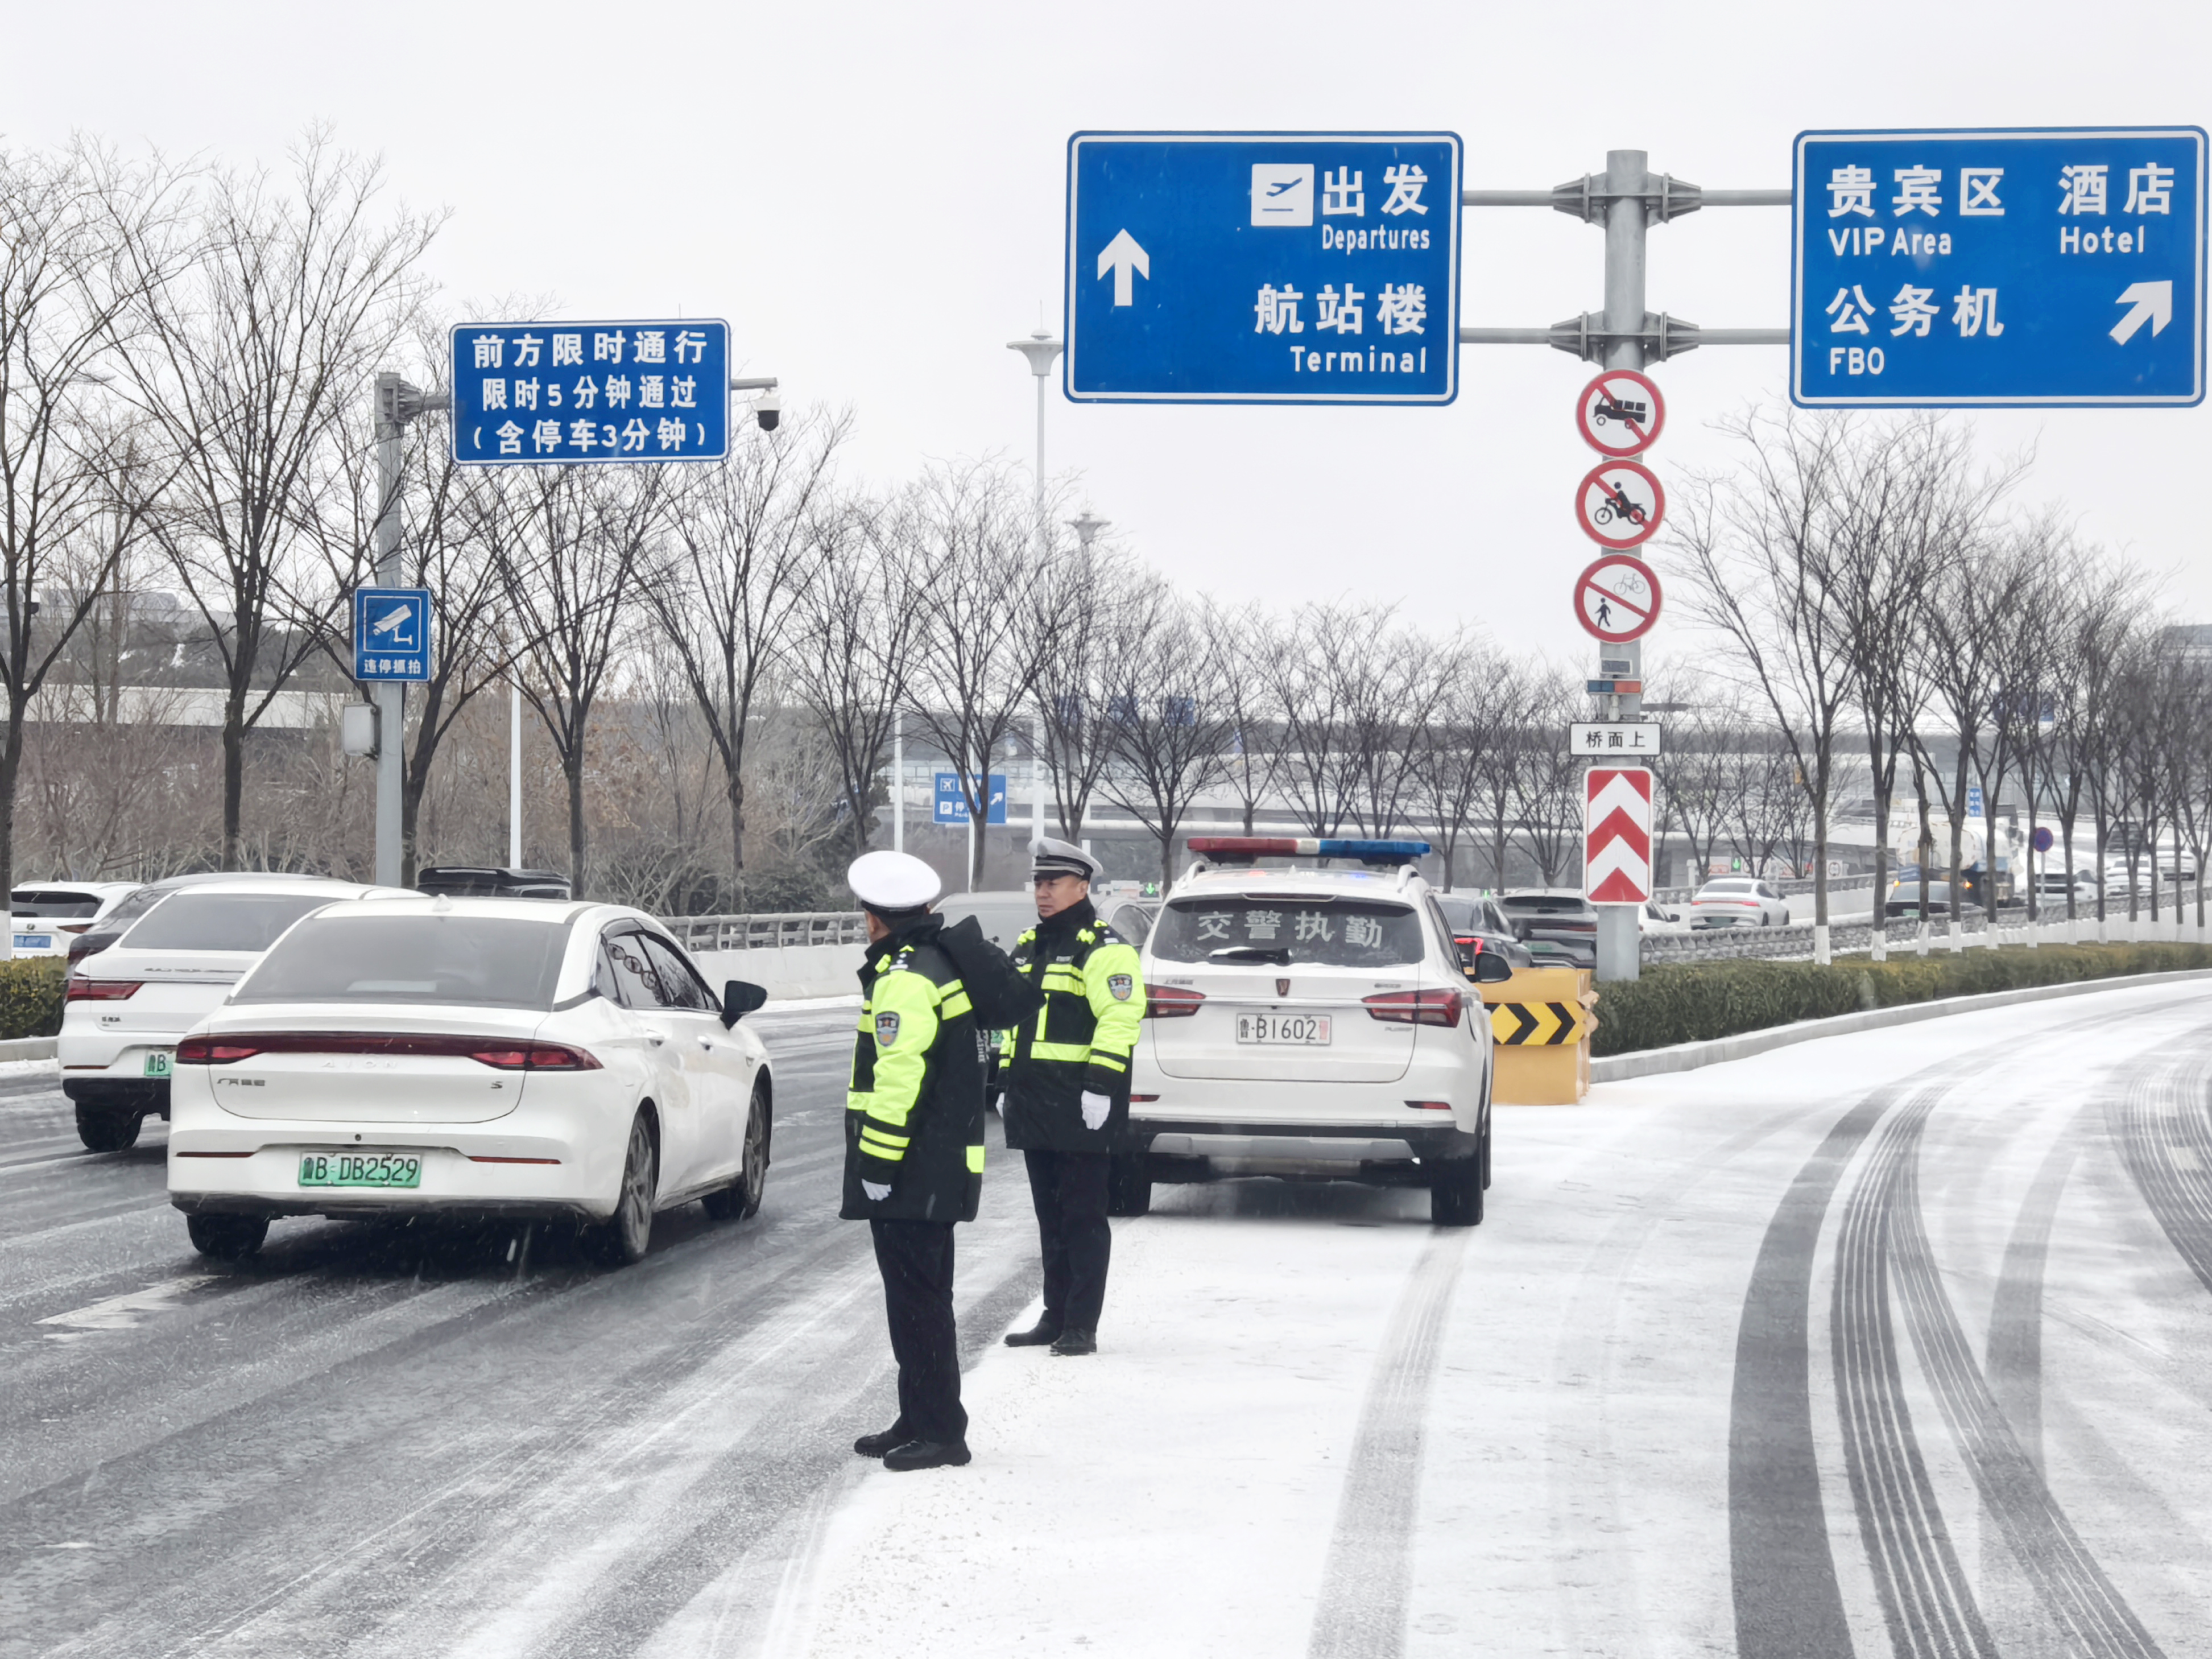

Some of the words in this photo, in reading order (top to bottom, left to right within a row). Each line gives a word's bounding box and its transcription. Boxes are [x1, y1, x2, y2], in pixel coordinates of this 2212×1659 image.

[1322, 164, 1429, 217] 出发
[1826, 164, 2005, 218] 贵宾区
[2058, 162, 2174, 216] 酒店
[1322, 224, 1430, 255] Departures
[1828, 227, 1885, 256] VIP
[1891, 227, 1951, 256] Area
[2060, 225, 2144, 254] Hotel
[1254, 283, 1427, 335] 航站楼
[1825, 284, 2004, 337] 公务机
[472, 329, 708, 369] 前方限时通行
[1289, 345, 1427, 373] Terminal
[1830, 347, 1885, 375] FBO
[482, 374, 697, 411] 限时5分钟通过
[1586, 731, 1645, 748] 桥面上
[1197, 910, 1382, 948] 交警执勤
